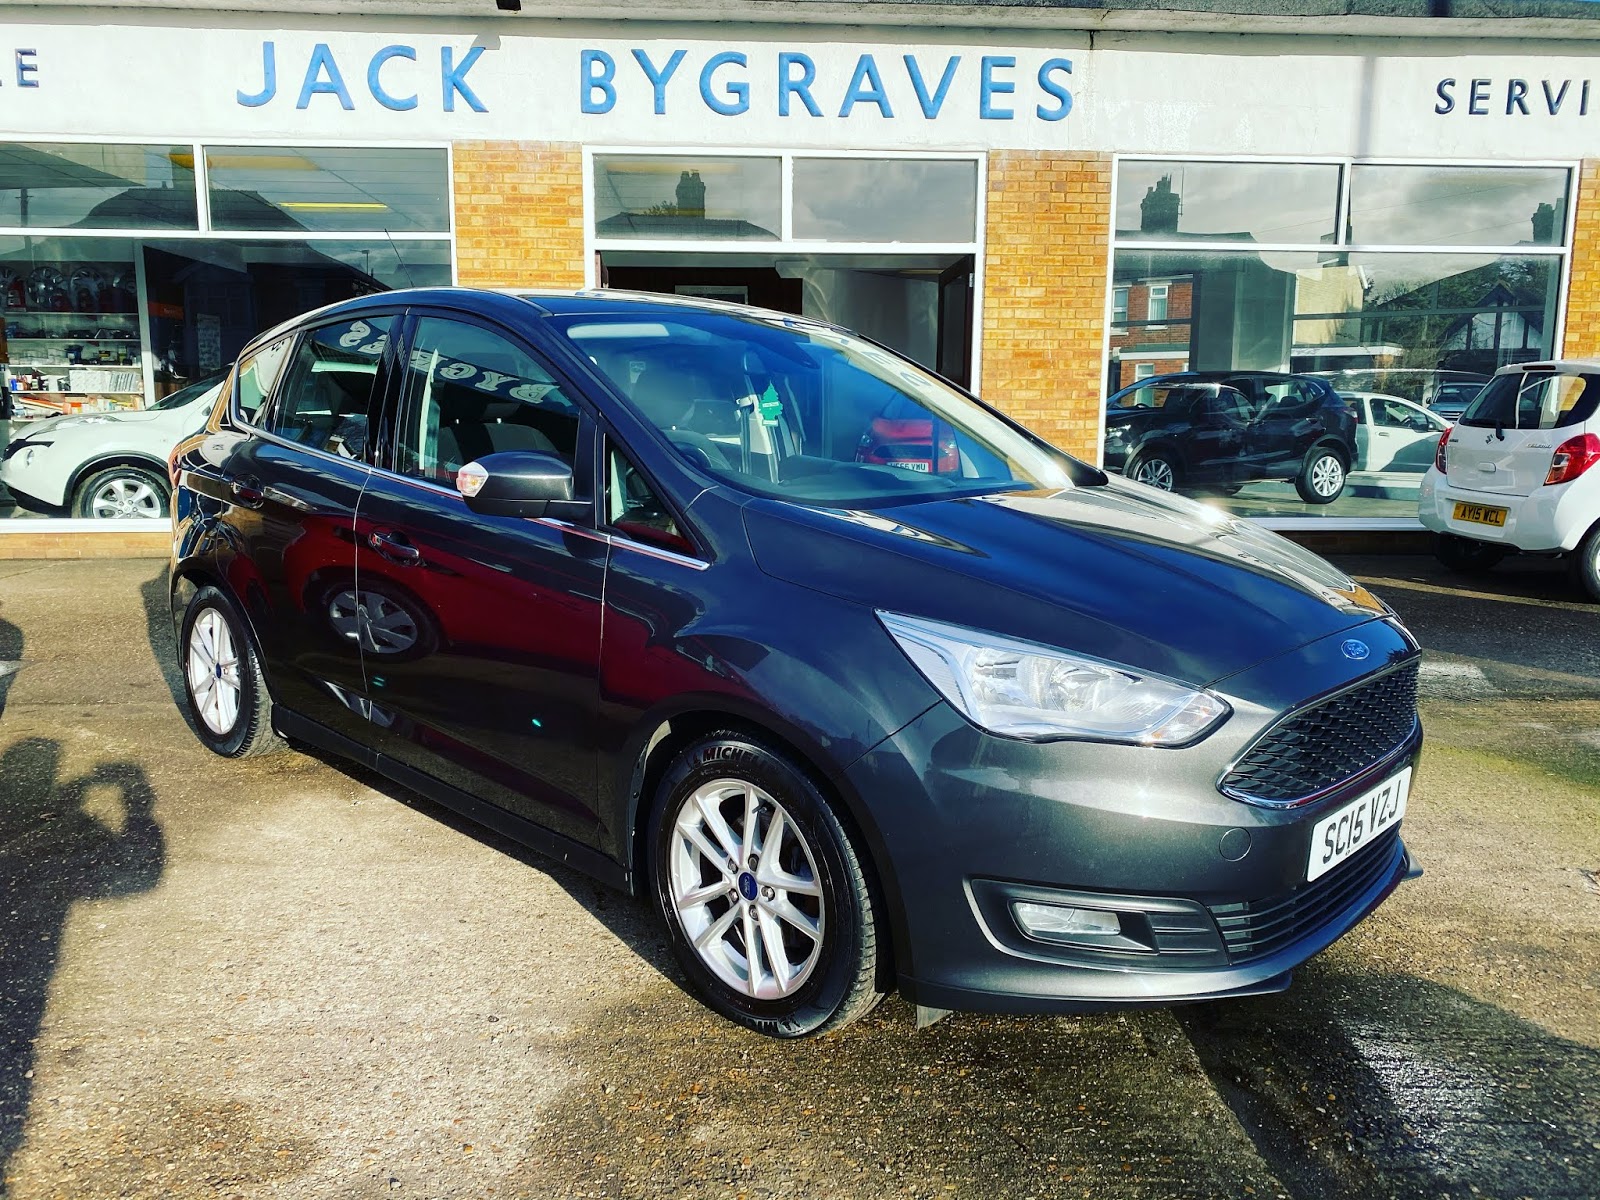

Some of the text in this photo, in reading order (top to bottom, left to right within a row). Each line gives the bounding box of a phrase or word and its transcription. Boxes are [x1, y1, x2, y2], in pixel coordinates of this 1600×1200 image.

[0, 49, 39, 88] E
[237, 41, 1073, 121] JACK BYGRAVES
[1434, 78, 1591, 116] SERVI
[1460, 505, 1500, 524] AY15 WCL
[1322, 779, 1402, 865] SC15 VZJ
